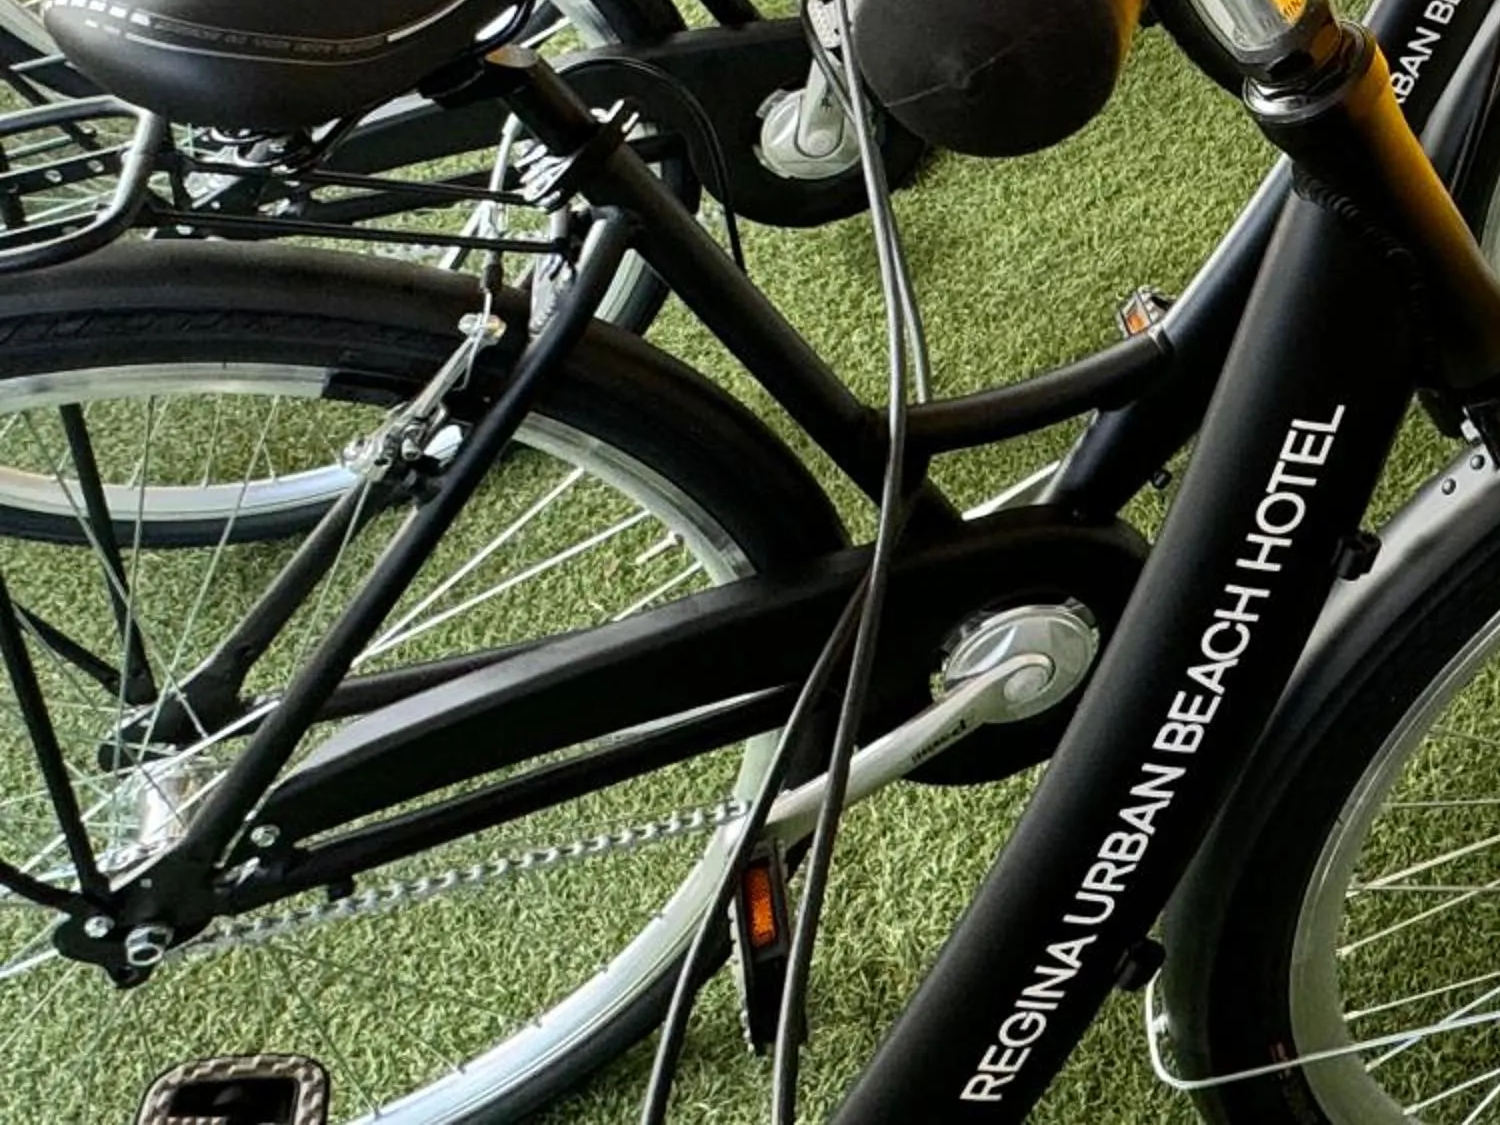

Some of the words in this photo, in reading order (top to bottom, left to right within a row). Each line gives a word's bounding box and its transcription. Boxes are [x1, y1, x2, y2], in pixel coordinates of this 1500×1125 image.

[1390, 26, 1441, 103] BAN
[960, 931, 1097, 1102] REGINA
[1064, 762, 1187, 927] URBAN
[1153, 582, 1269, 754] BEACH
[1236, 404, 1345, 573] HOTEL
